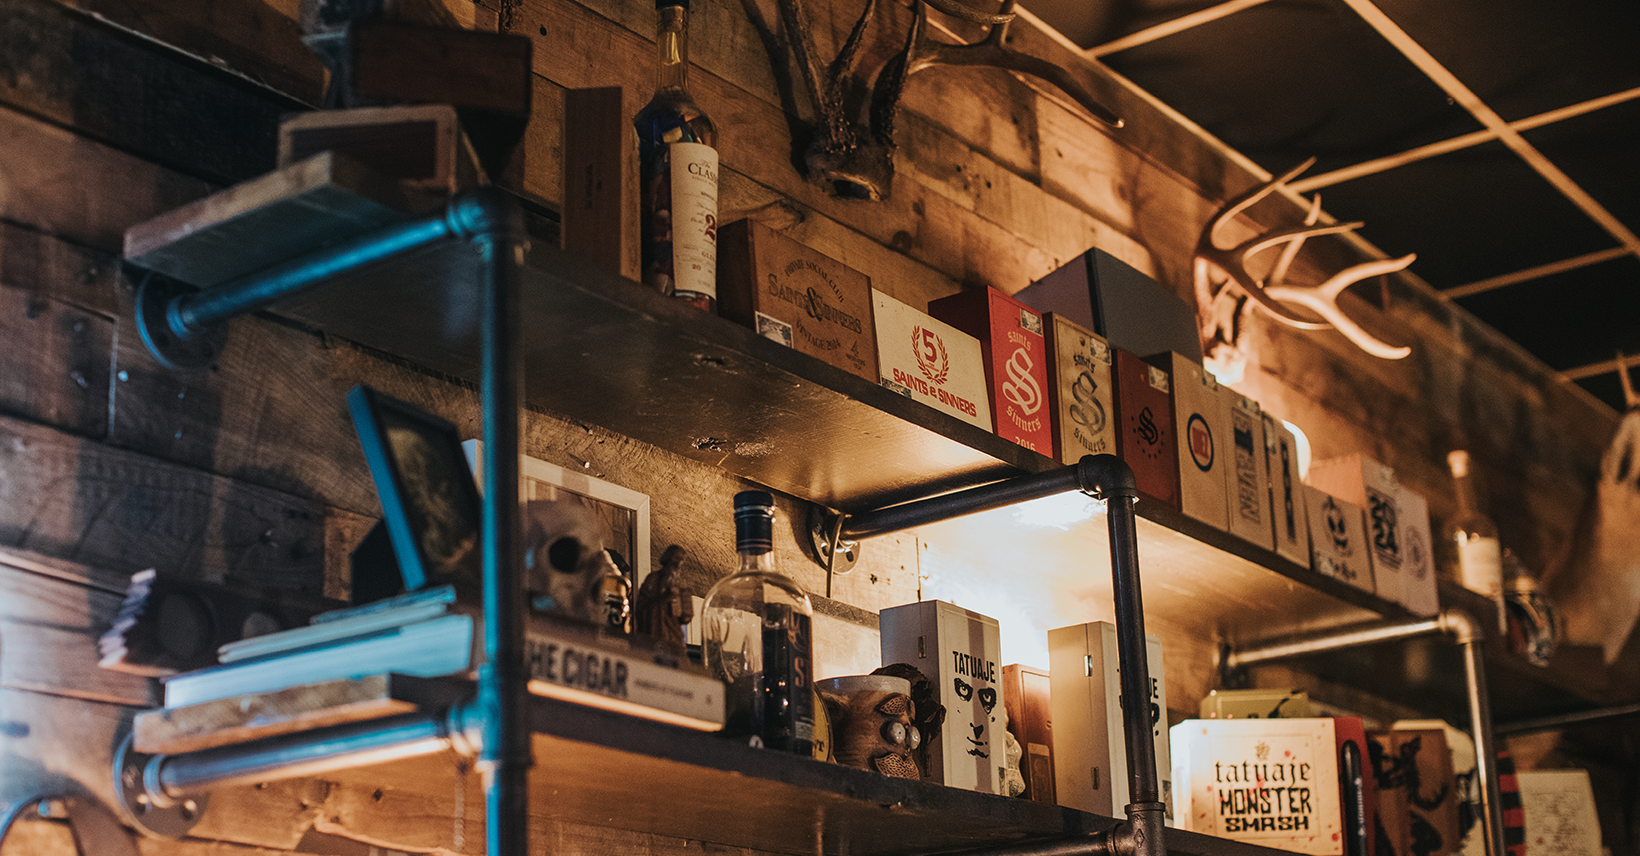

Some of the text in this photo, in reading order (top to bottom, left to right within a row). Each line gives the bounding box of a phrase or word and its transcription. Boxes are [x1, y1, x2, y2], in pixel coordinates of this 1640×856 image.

[806, 260, 828, 280] SOCIAL
[922, 327, 938, 363] 5
[892, 367, 929, 397] SAINTS
[937, 387, 977, 418] SINNERS
[561, 647, 629, 699] CIGAR
[952, 650, 996, 684] TATUAJE
[1215, 760, 1311, 788] tatuaje
[1219, 786, 1312, 815] MONSTER
[1225, 815, 1310, 833] SMASH
